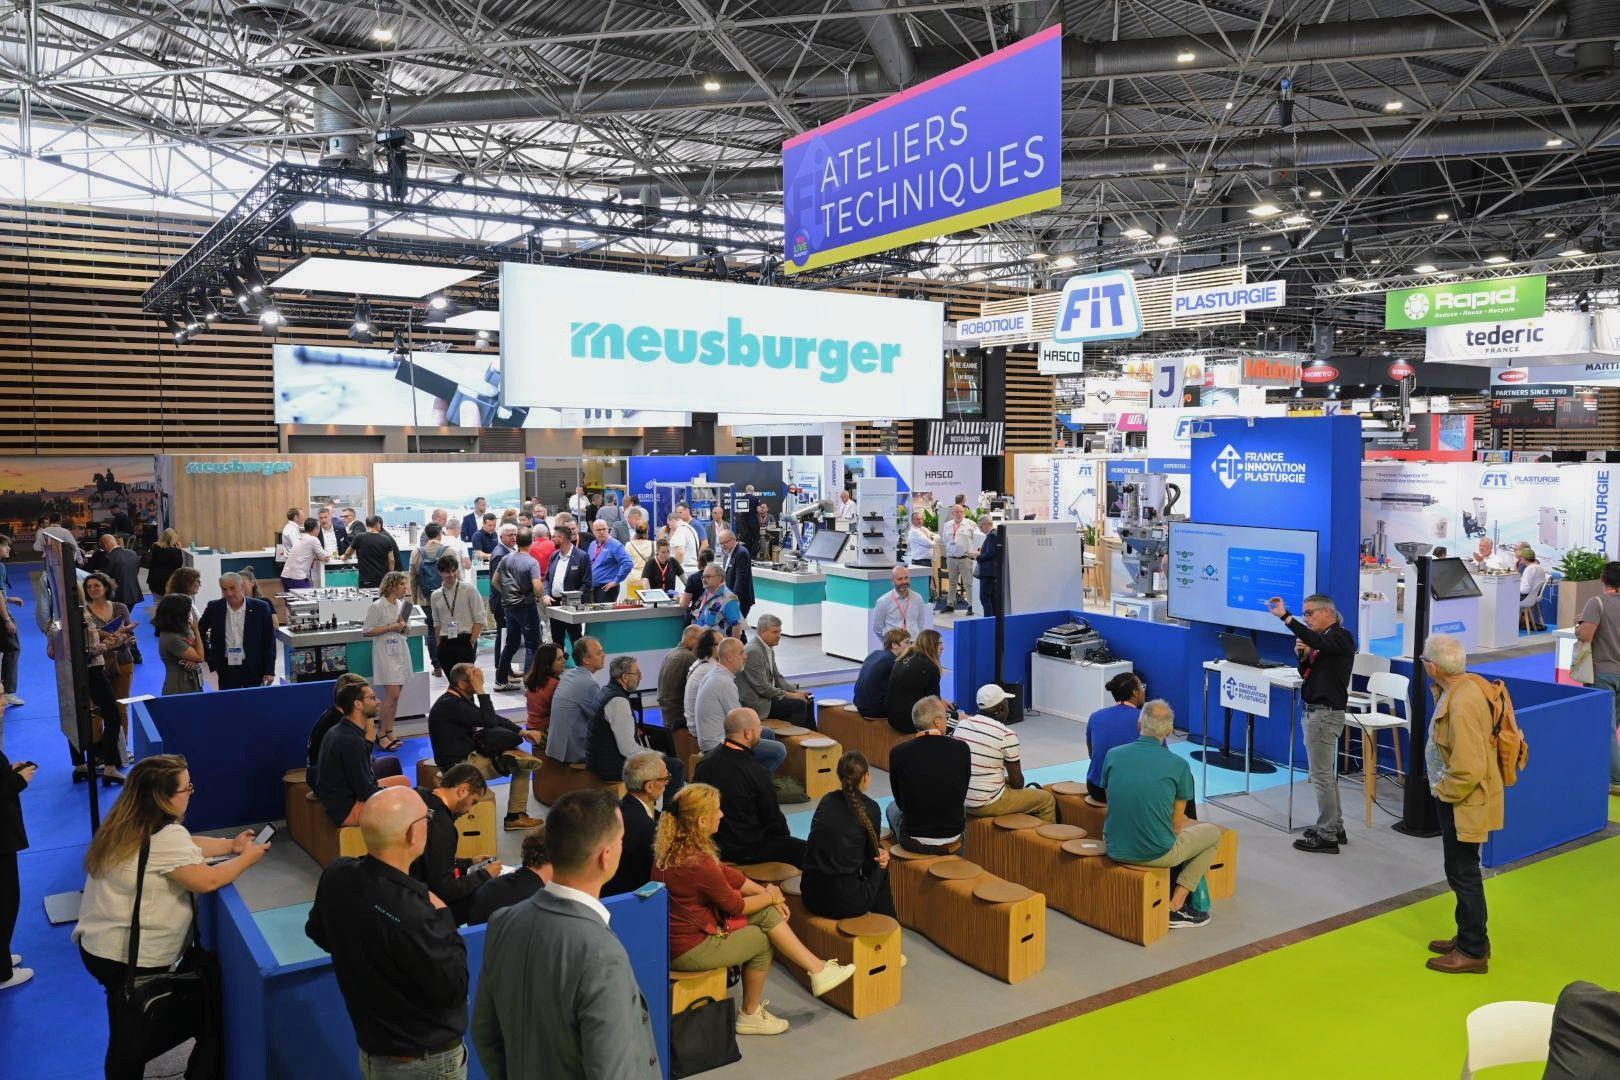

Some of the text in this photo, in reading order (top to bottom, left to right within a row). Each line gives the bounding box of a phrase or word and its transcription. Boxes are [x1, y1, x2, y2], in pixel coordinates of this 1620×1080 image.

[821, 105, 968, 193] ATELIERS
[821, 135, 1045, 237] TECHNIQUES
[1175, 286, 1277, 312] PLASTURGIE
[961, 315, 1025, 337] ROBOTIQUE
[1466, 322, 1544, 346] tederic
[570, 316, 902, 384] meusburger
[1043, 350, 1080, 362] HASCO
[1485, 346, 1520, 354] FRANCE
[1158, 365, 1176, 398] J
[1495, 388, 1567, 397] PARTNERS SINCE 1993
[950, 435, 981, 443] RESTAURANTS
[1244, 452, 1285, 462] FRANCE
[185, 459, 293, 475] meusburger
[1244, 462, 1306, 473] INNOVATION
[925, 470, 953, 479] HASCO
[1244, 472, 1306, 483] PLASTURGIE
[1514, 475, 1561, 483] PLASTURGIE
[1052, 461, 1060, 520] ROBOTIQUE
[1238, 687, 1268, 700] INNOVATION
